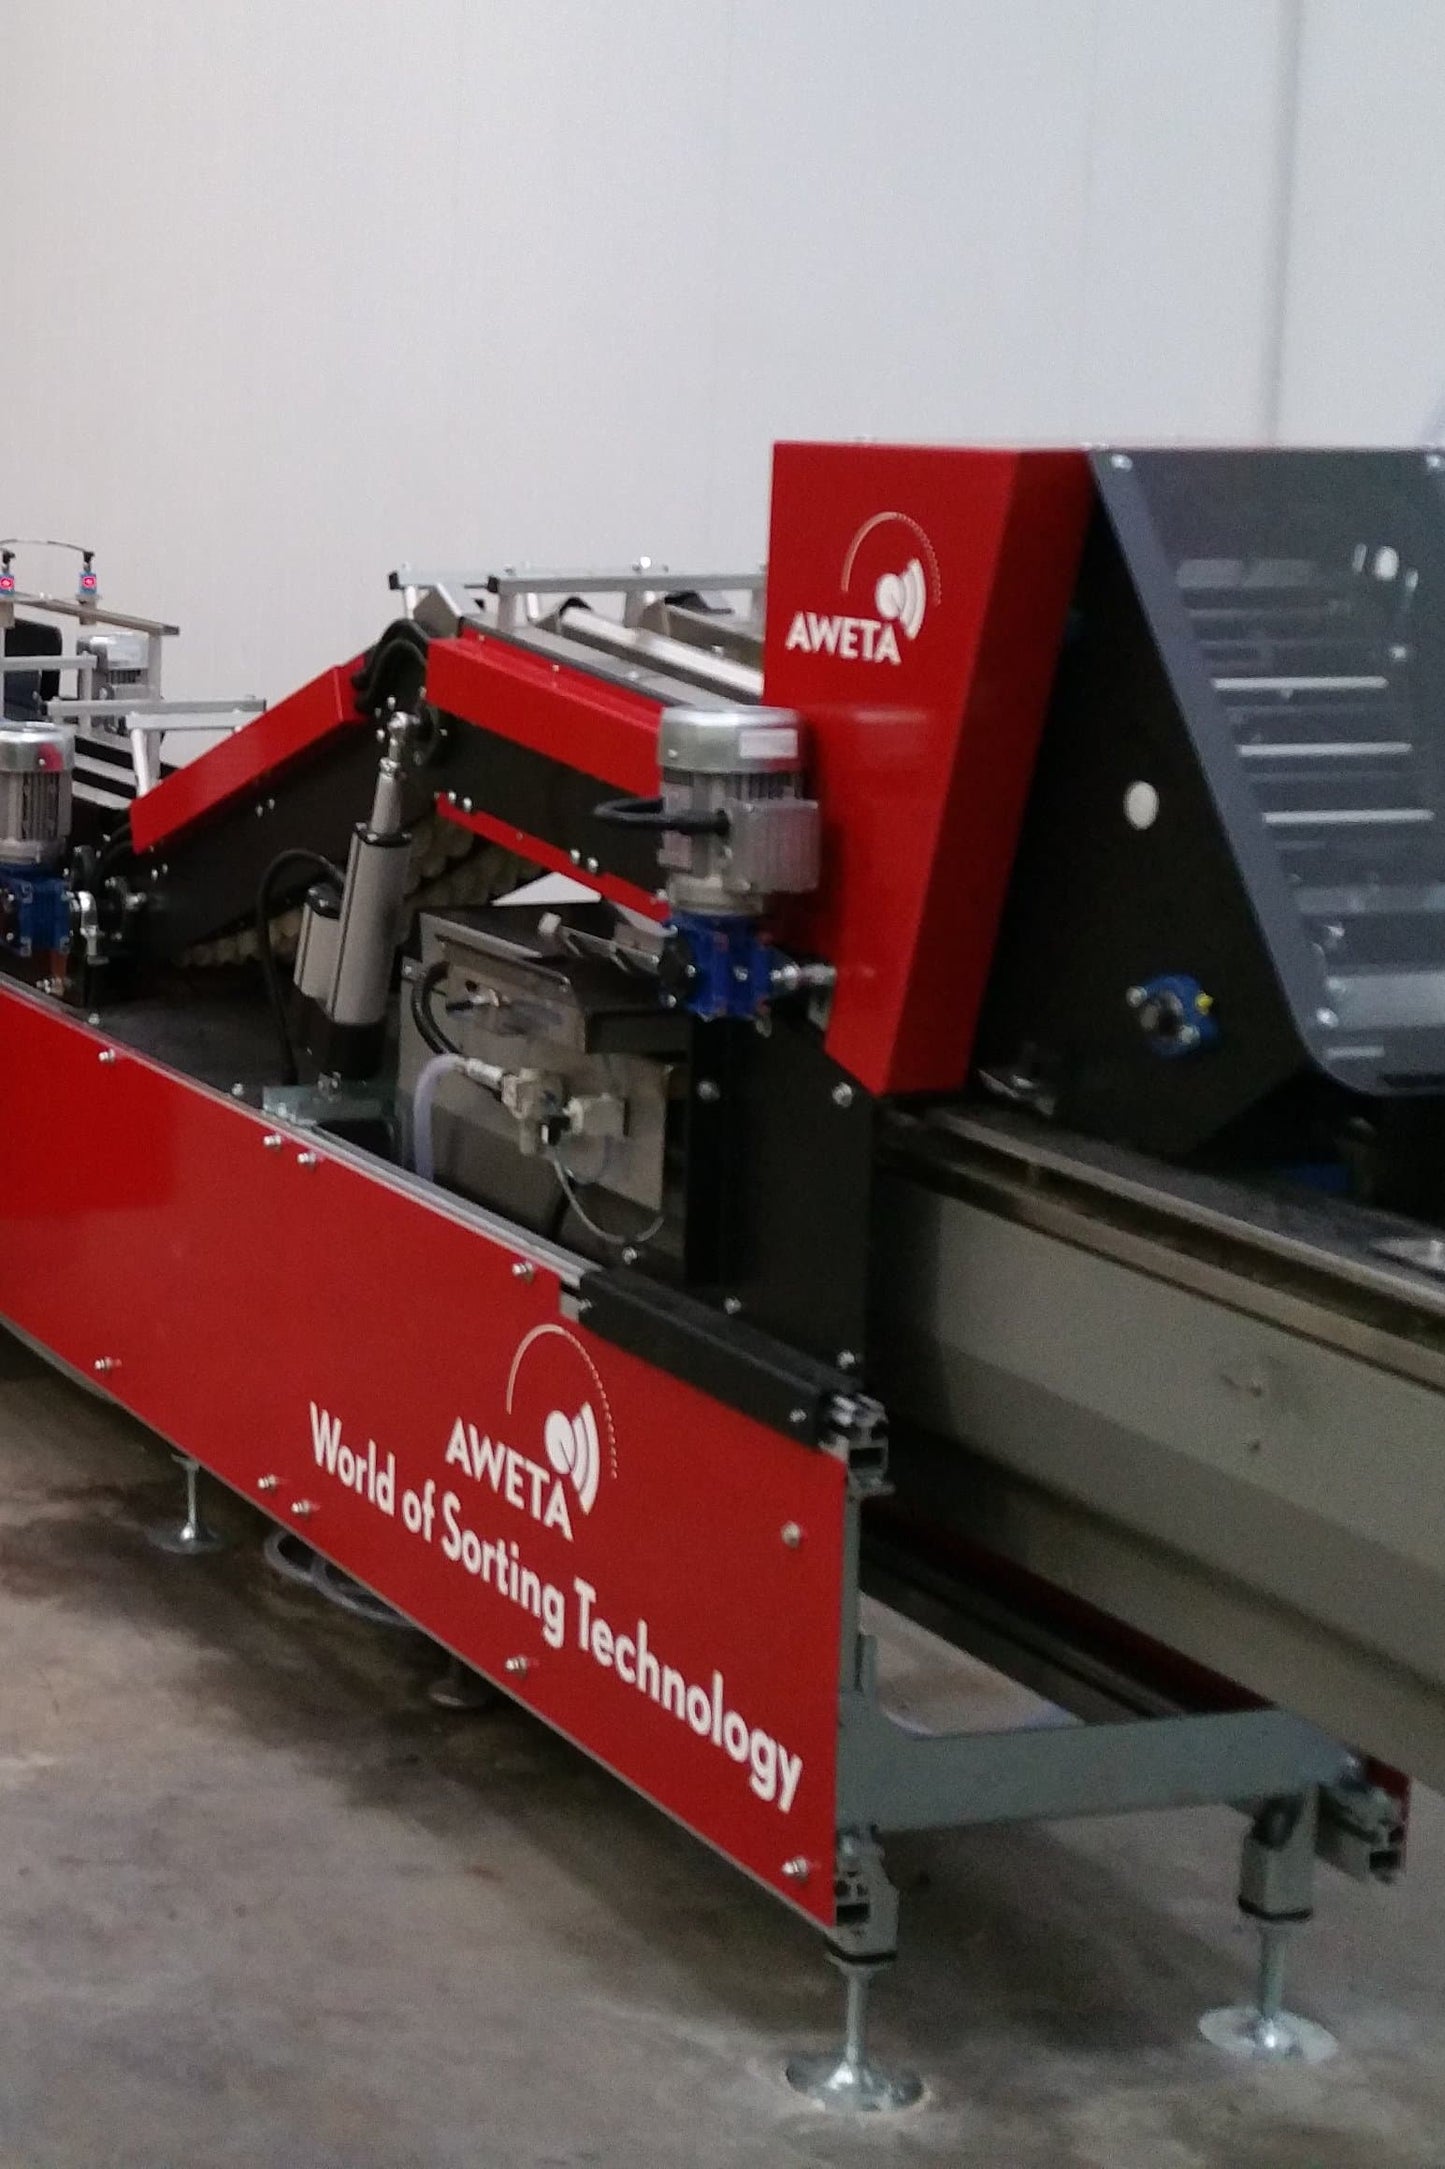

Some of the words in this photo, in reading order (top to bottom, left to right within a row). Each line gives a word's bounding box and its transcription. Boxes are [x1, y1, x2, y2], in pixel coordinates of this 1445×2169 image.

[785, 611, 902, 665] AWETA
[445, 1416, 574, 1542] AWETA
[309, 1400, 394, 1517] World
[402, 1478, 436, 1543] of
[441, 1491, 565, 1649] Sorting
[573, 1576, 803, 1814] Technology
